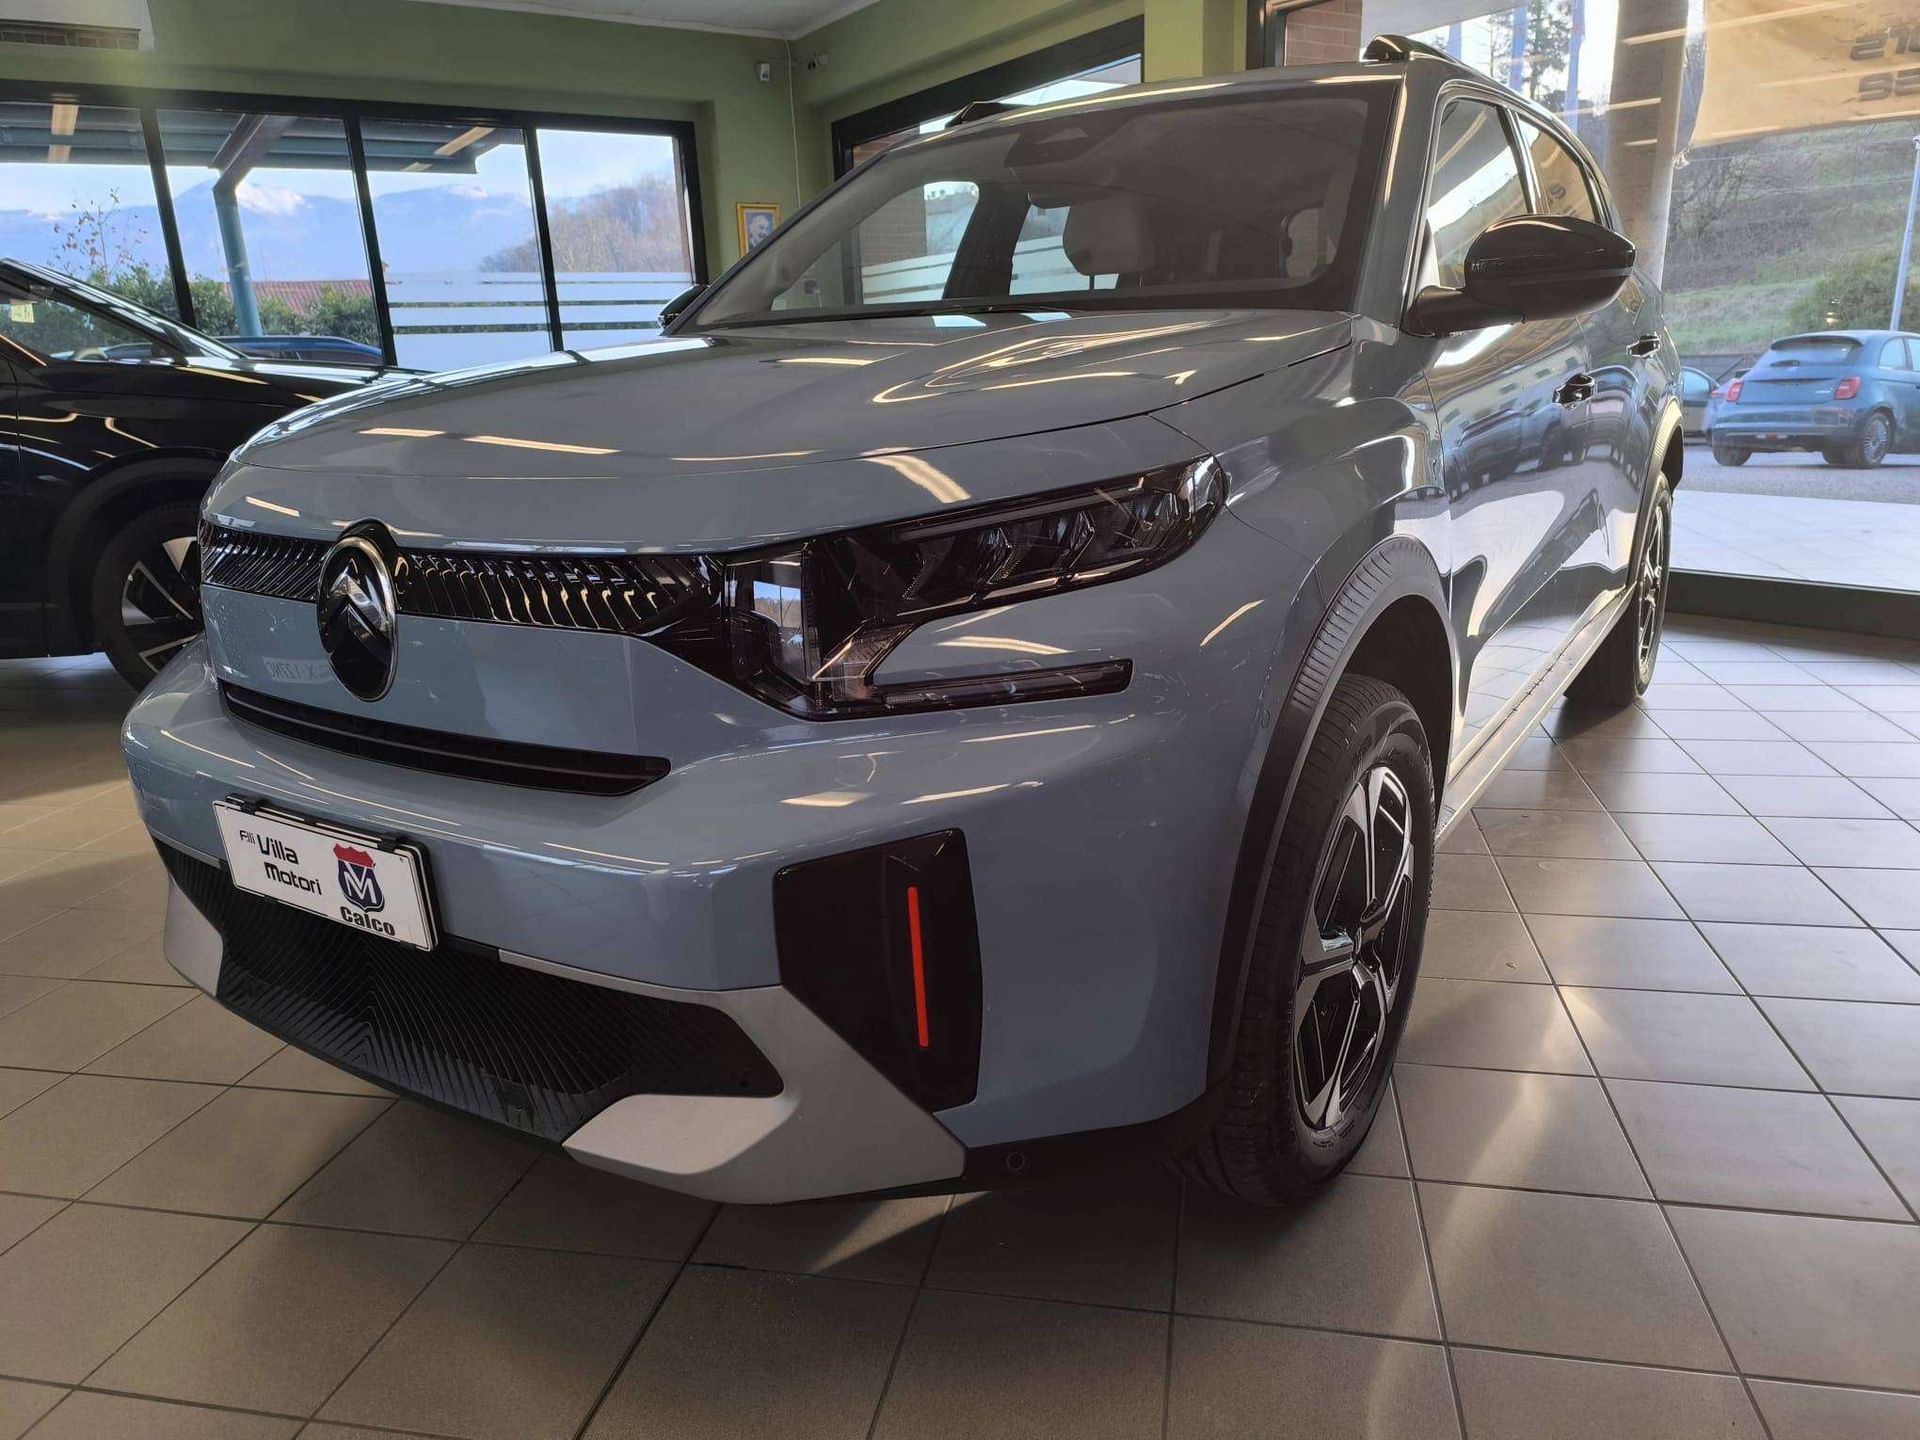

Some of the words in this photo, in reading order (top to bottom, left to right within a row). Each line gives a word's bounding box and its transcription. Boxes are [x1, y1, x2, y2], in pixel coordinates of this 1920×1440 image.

[257, 834, 299, 864] Villa
[264, 862, 322, 895] Motori
[340, 906, 395, 936] Calco
